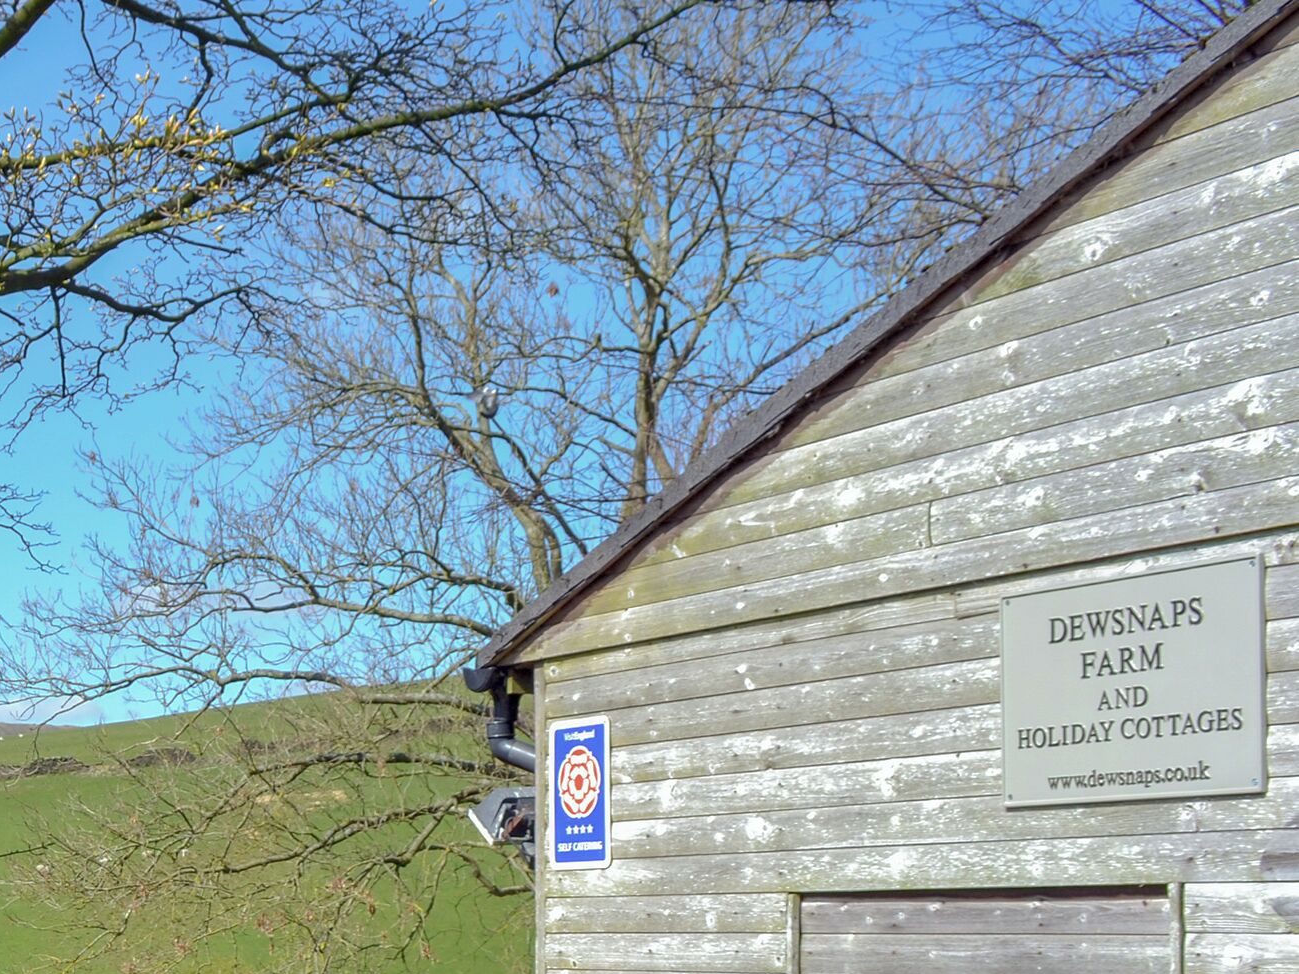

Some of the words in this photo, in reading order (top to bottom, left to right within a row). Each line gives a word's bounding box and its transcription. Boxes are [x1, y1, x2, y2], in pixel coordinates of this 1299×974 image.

[1048, 597, 1204, 645] DEWSNAPS
[1080, 642, 1165, 679] FARM
[1097, 685, 1149, 711] AND
[1017, 720, 1115, 749] HOLIDAY
[1120, 708, 1244, 740] COTTAGES
[1047, 760, 1211, 790] www.dewsnaps.co.uk
